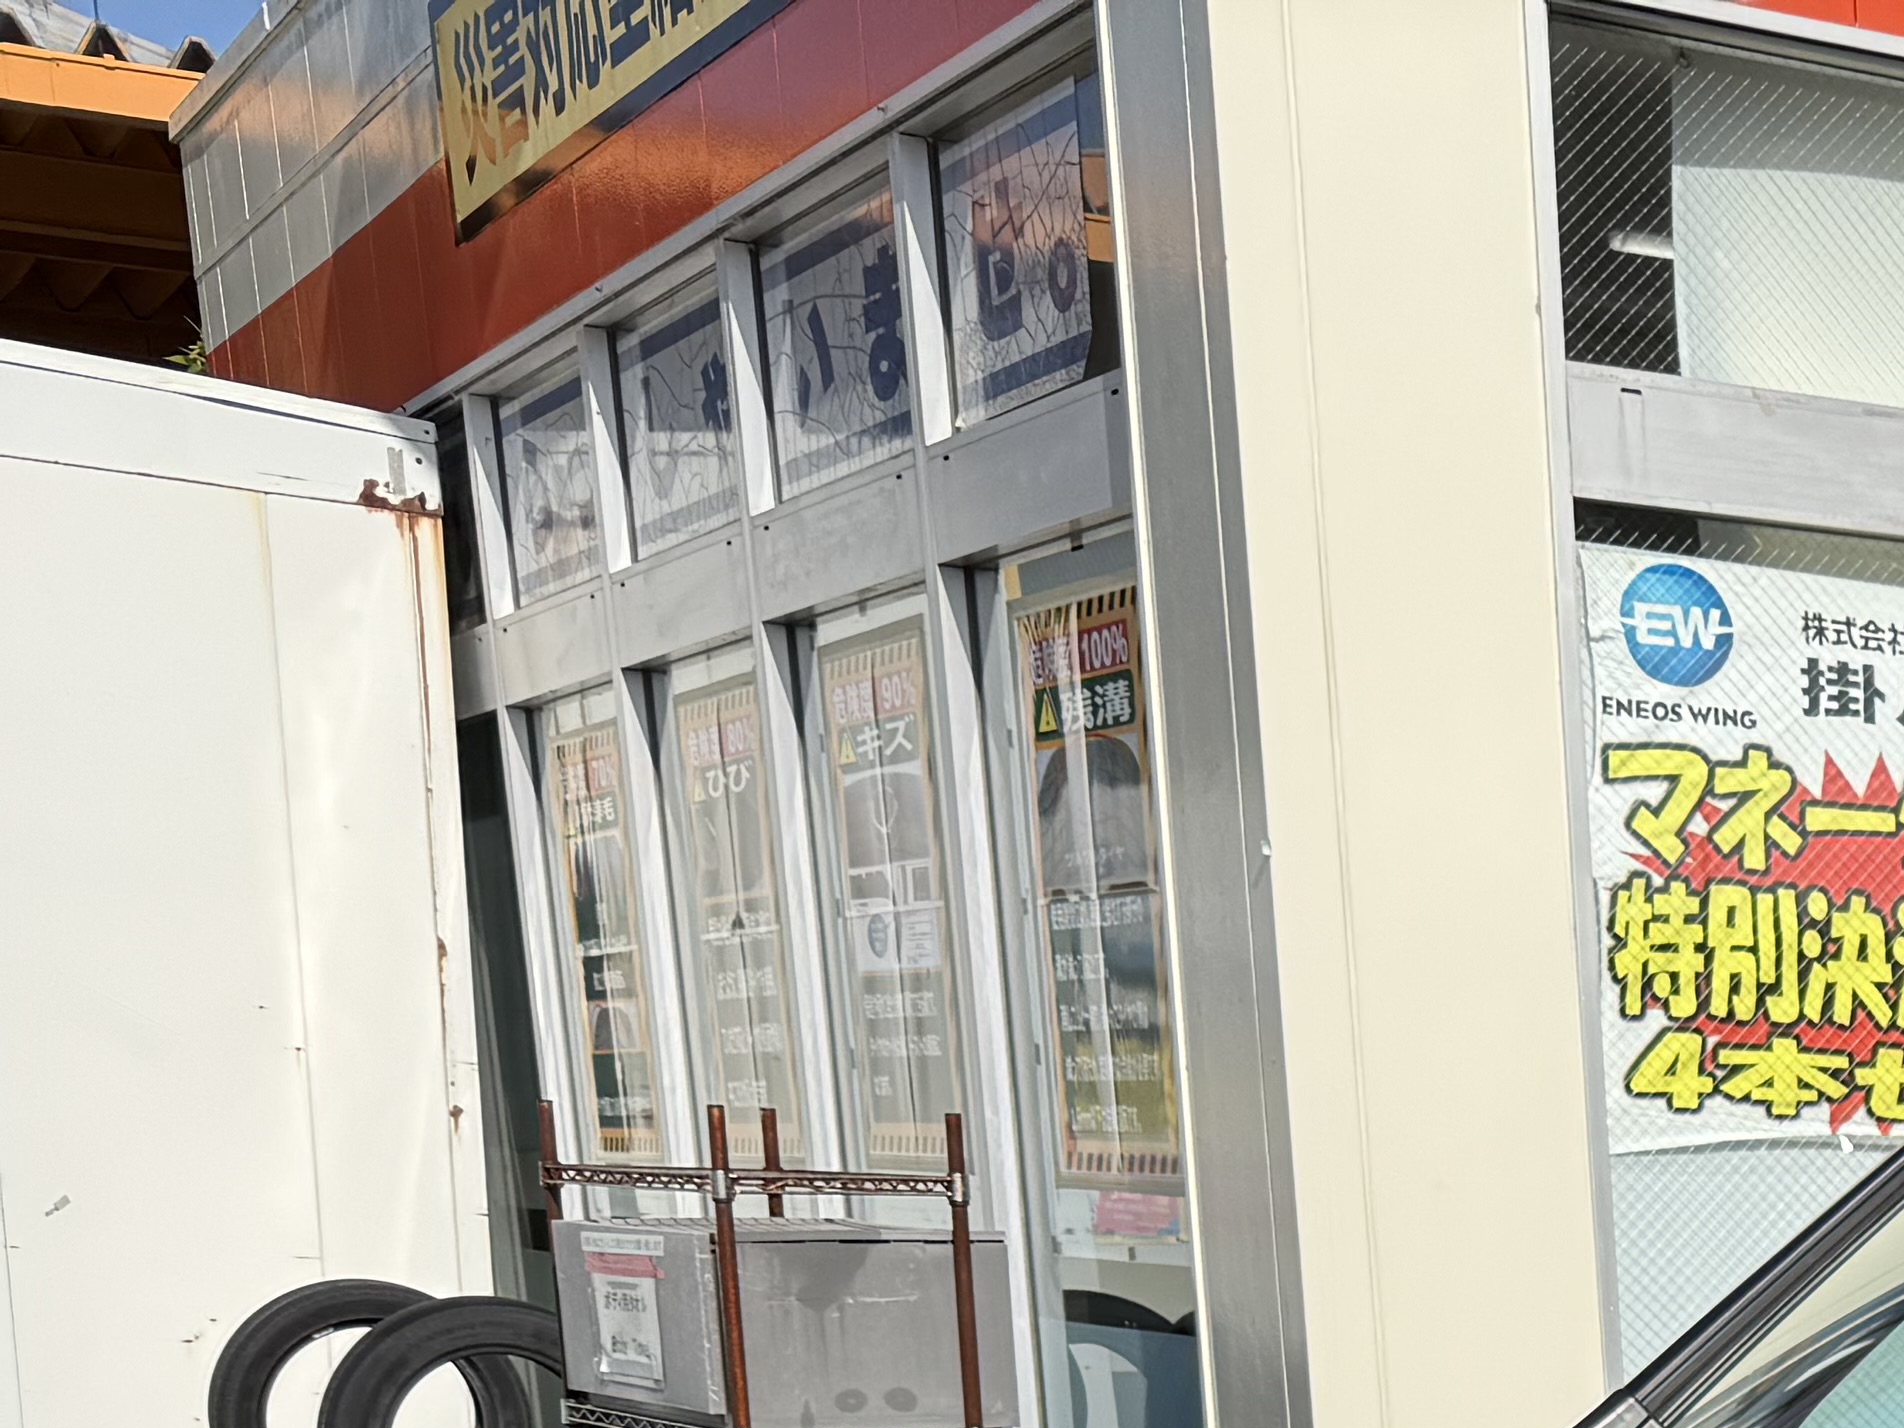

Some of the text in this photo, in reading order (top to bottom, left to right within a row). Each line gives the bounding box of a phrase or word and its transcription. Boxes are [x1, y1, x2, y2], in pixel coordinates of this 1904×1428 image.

[1081, 622, 1129, 671] 100%
[1633, 600, 1721, 651] EW
[881, 671, 916, 710] 90%
[1601, 695, 1758, 730] ENEOS WING
[856, 713, 915, 761] キズ
[705, 759, 753, 798] ひび
